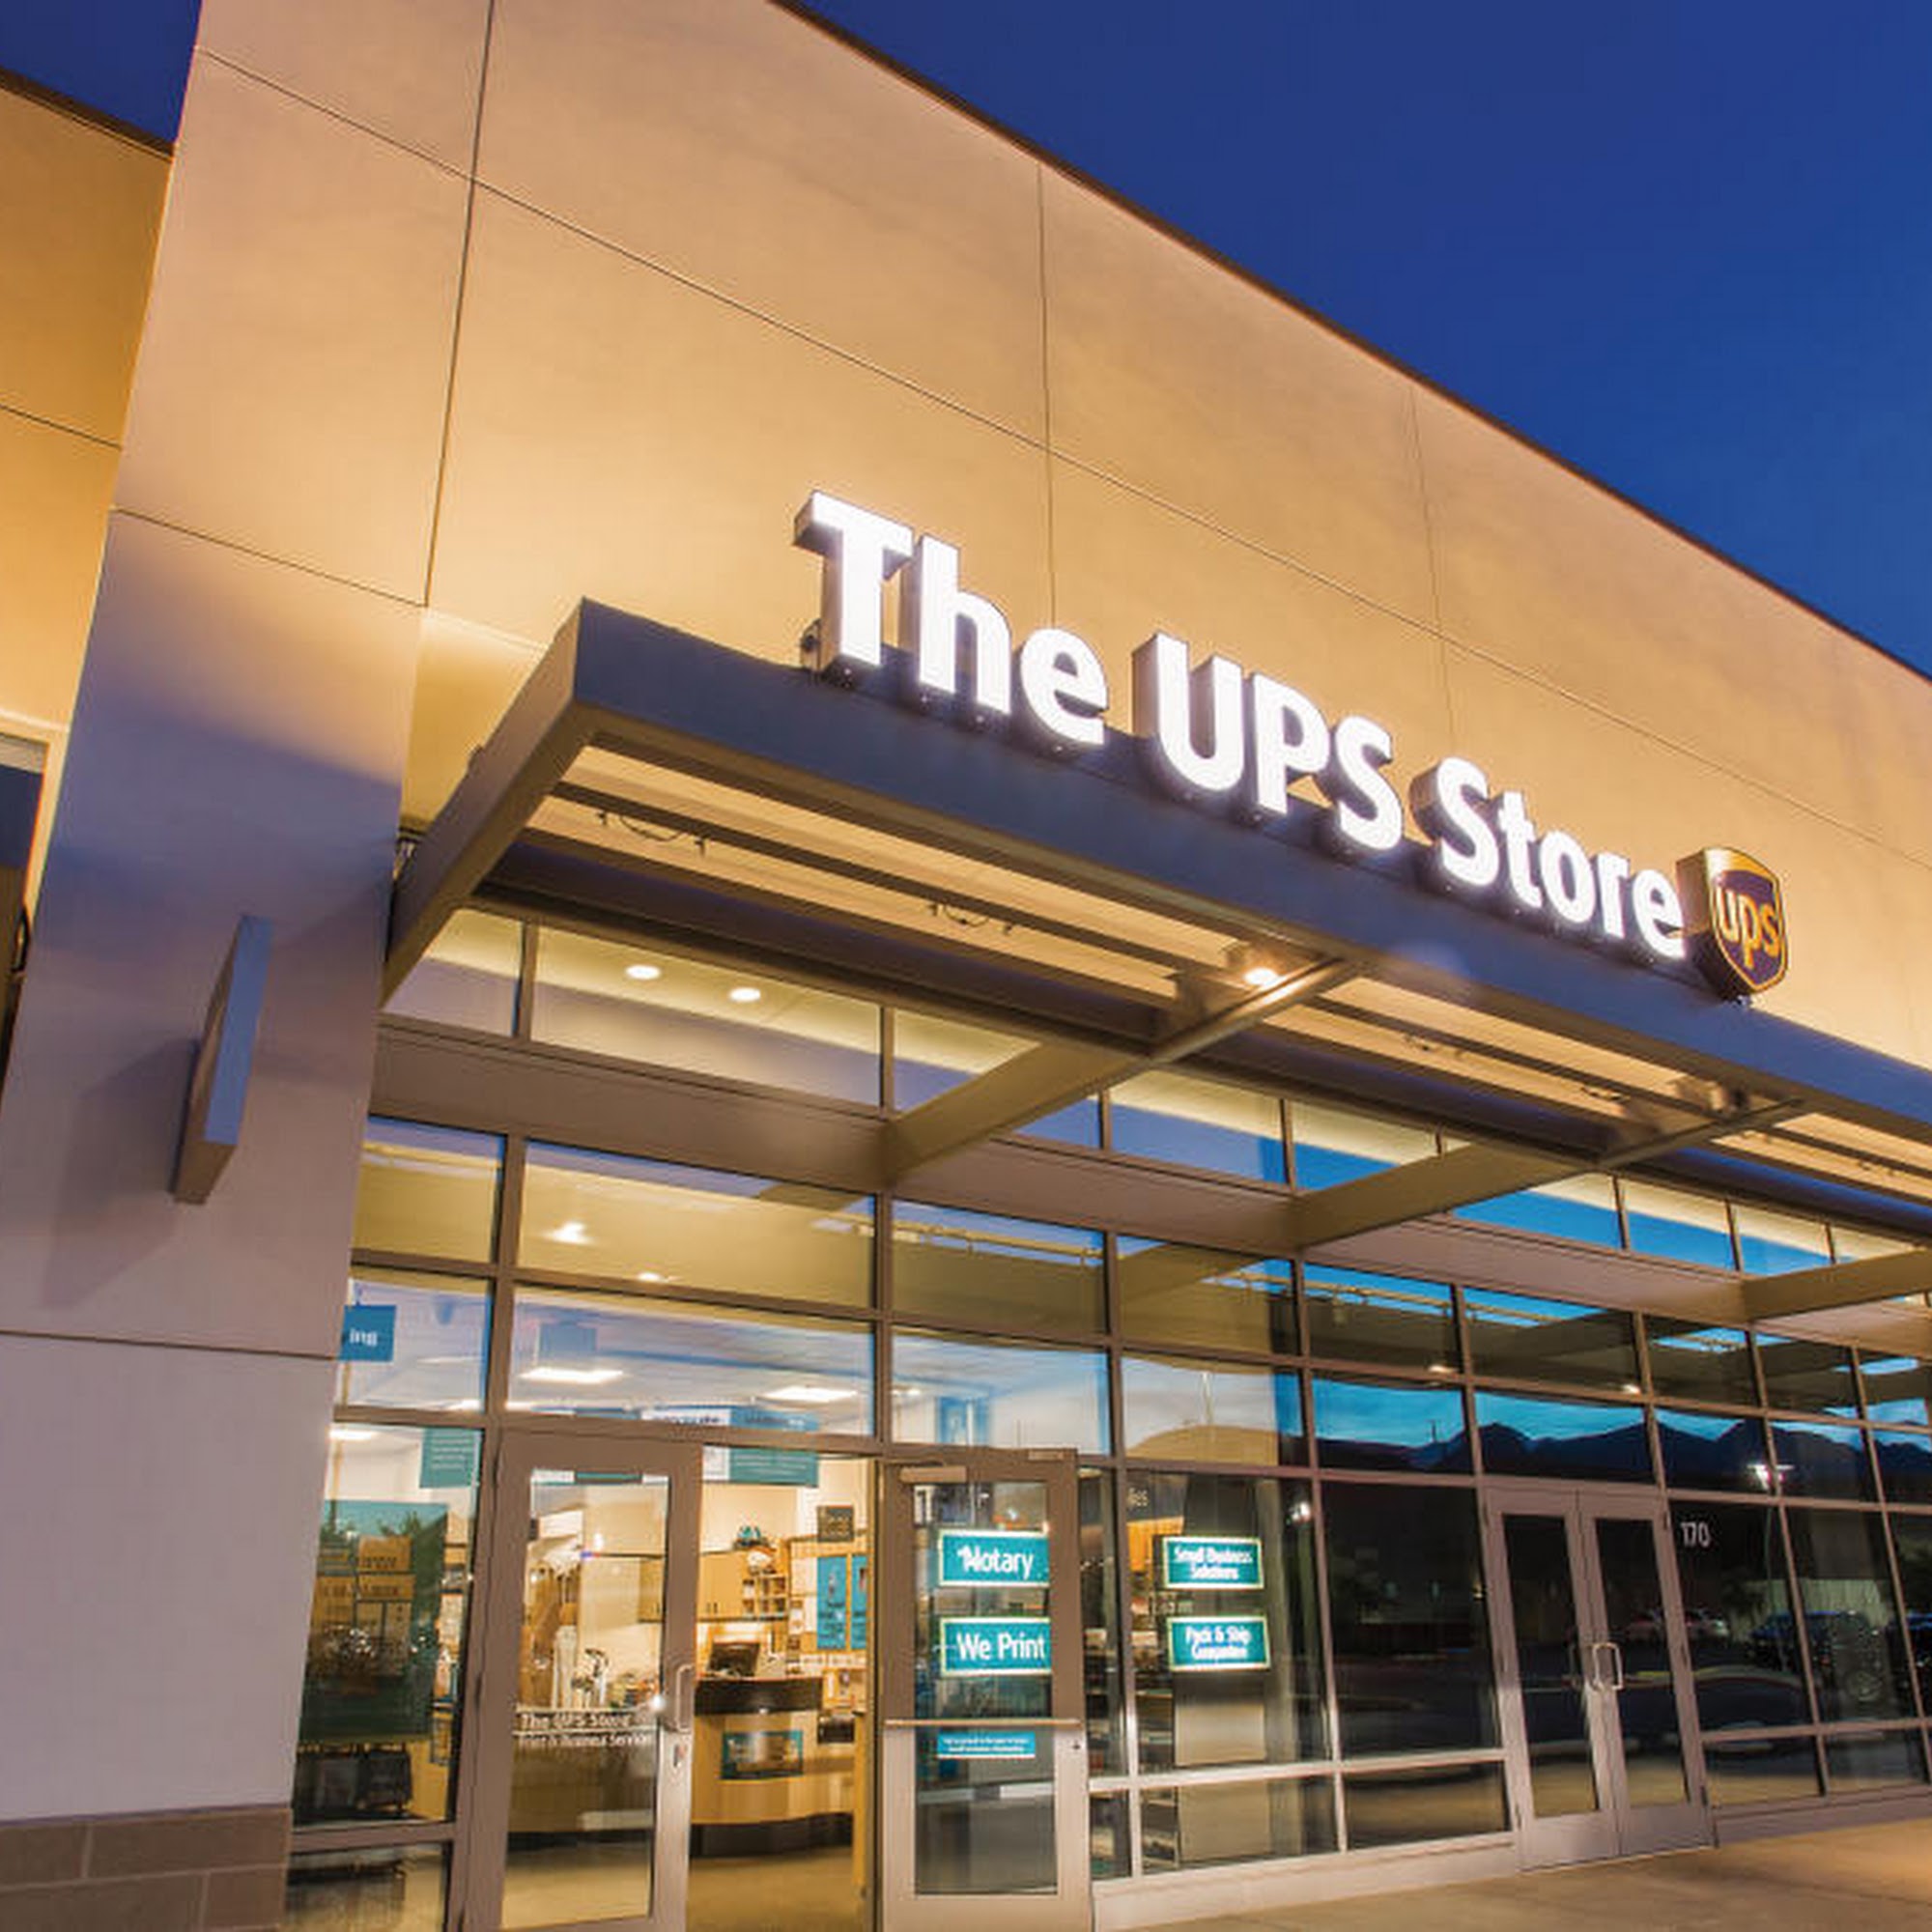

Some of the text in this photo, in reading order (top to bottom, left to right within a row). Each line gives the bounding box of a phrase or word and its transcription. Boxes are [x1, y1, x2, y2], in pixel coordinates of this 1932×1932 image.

[804, 490, 1687, 960] The UPS Store
[1715, 884, 1781, 970] ups
[349, 1327, 378, 1348] ing
[1680, 1520, 1711, 1548] 170
[956, 1545, 1035, 1580] Notary
[954, 1630, 1046, 1662] We Print
